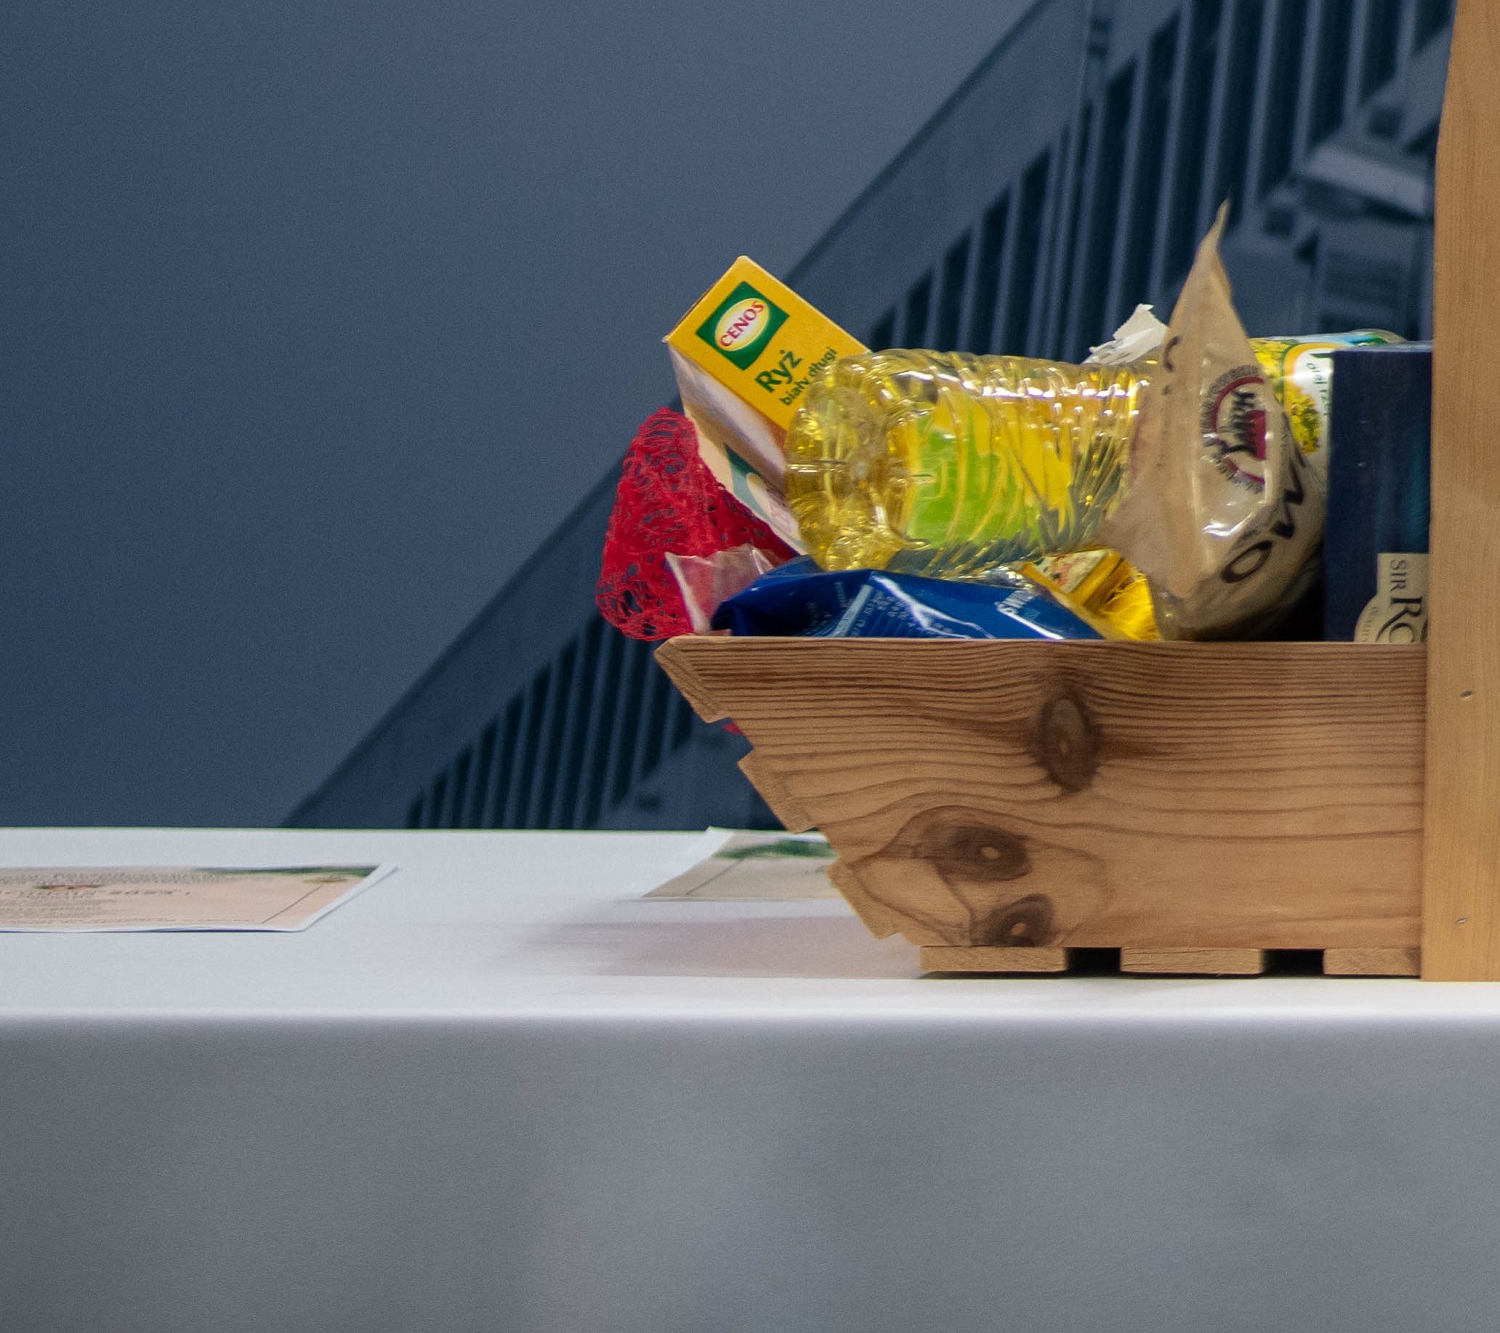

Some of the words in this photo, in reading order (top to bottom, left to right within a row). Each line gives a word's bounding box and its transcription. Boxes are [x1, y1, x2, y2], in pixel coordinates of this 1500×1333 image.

[719, 300, 765, 347] CENOS
[754, 349, 803, 394] Ryż
[1390, 559, 1409, 593] SIR
